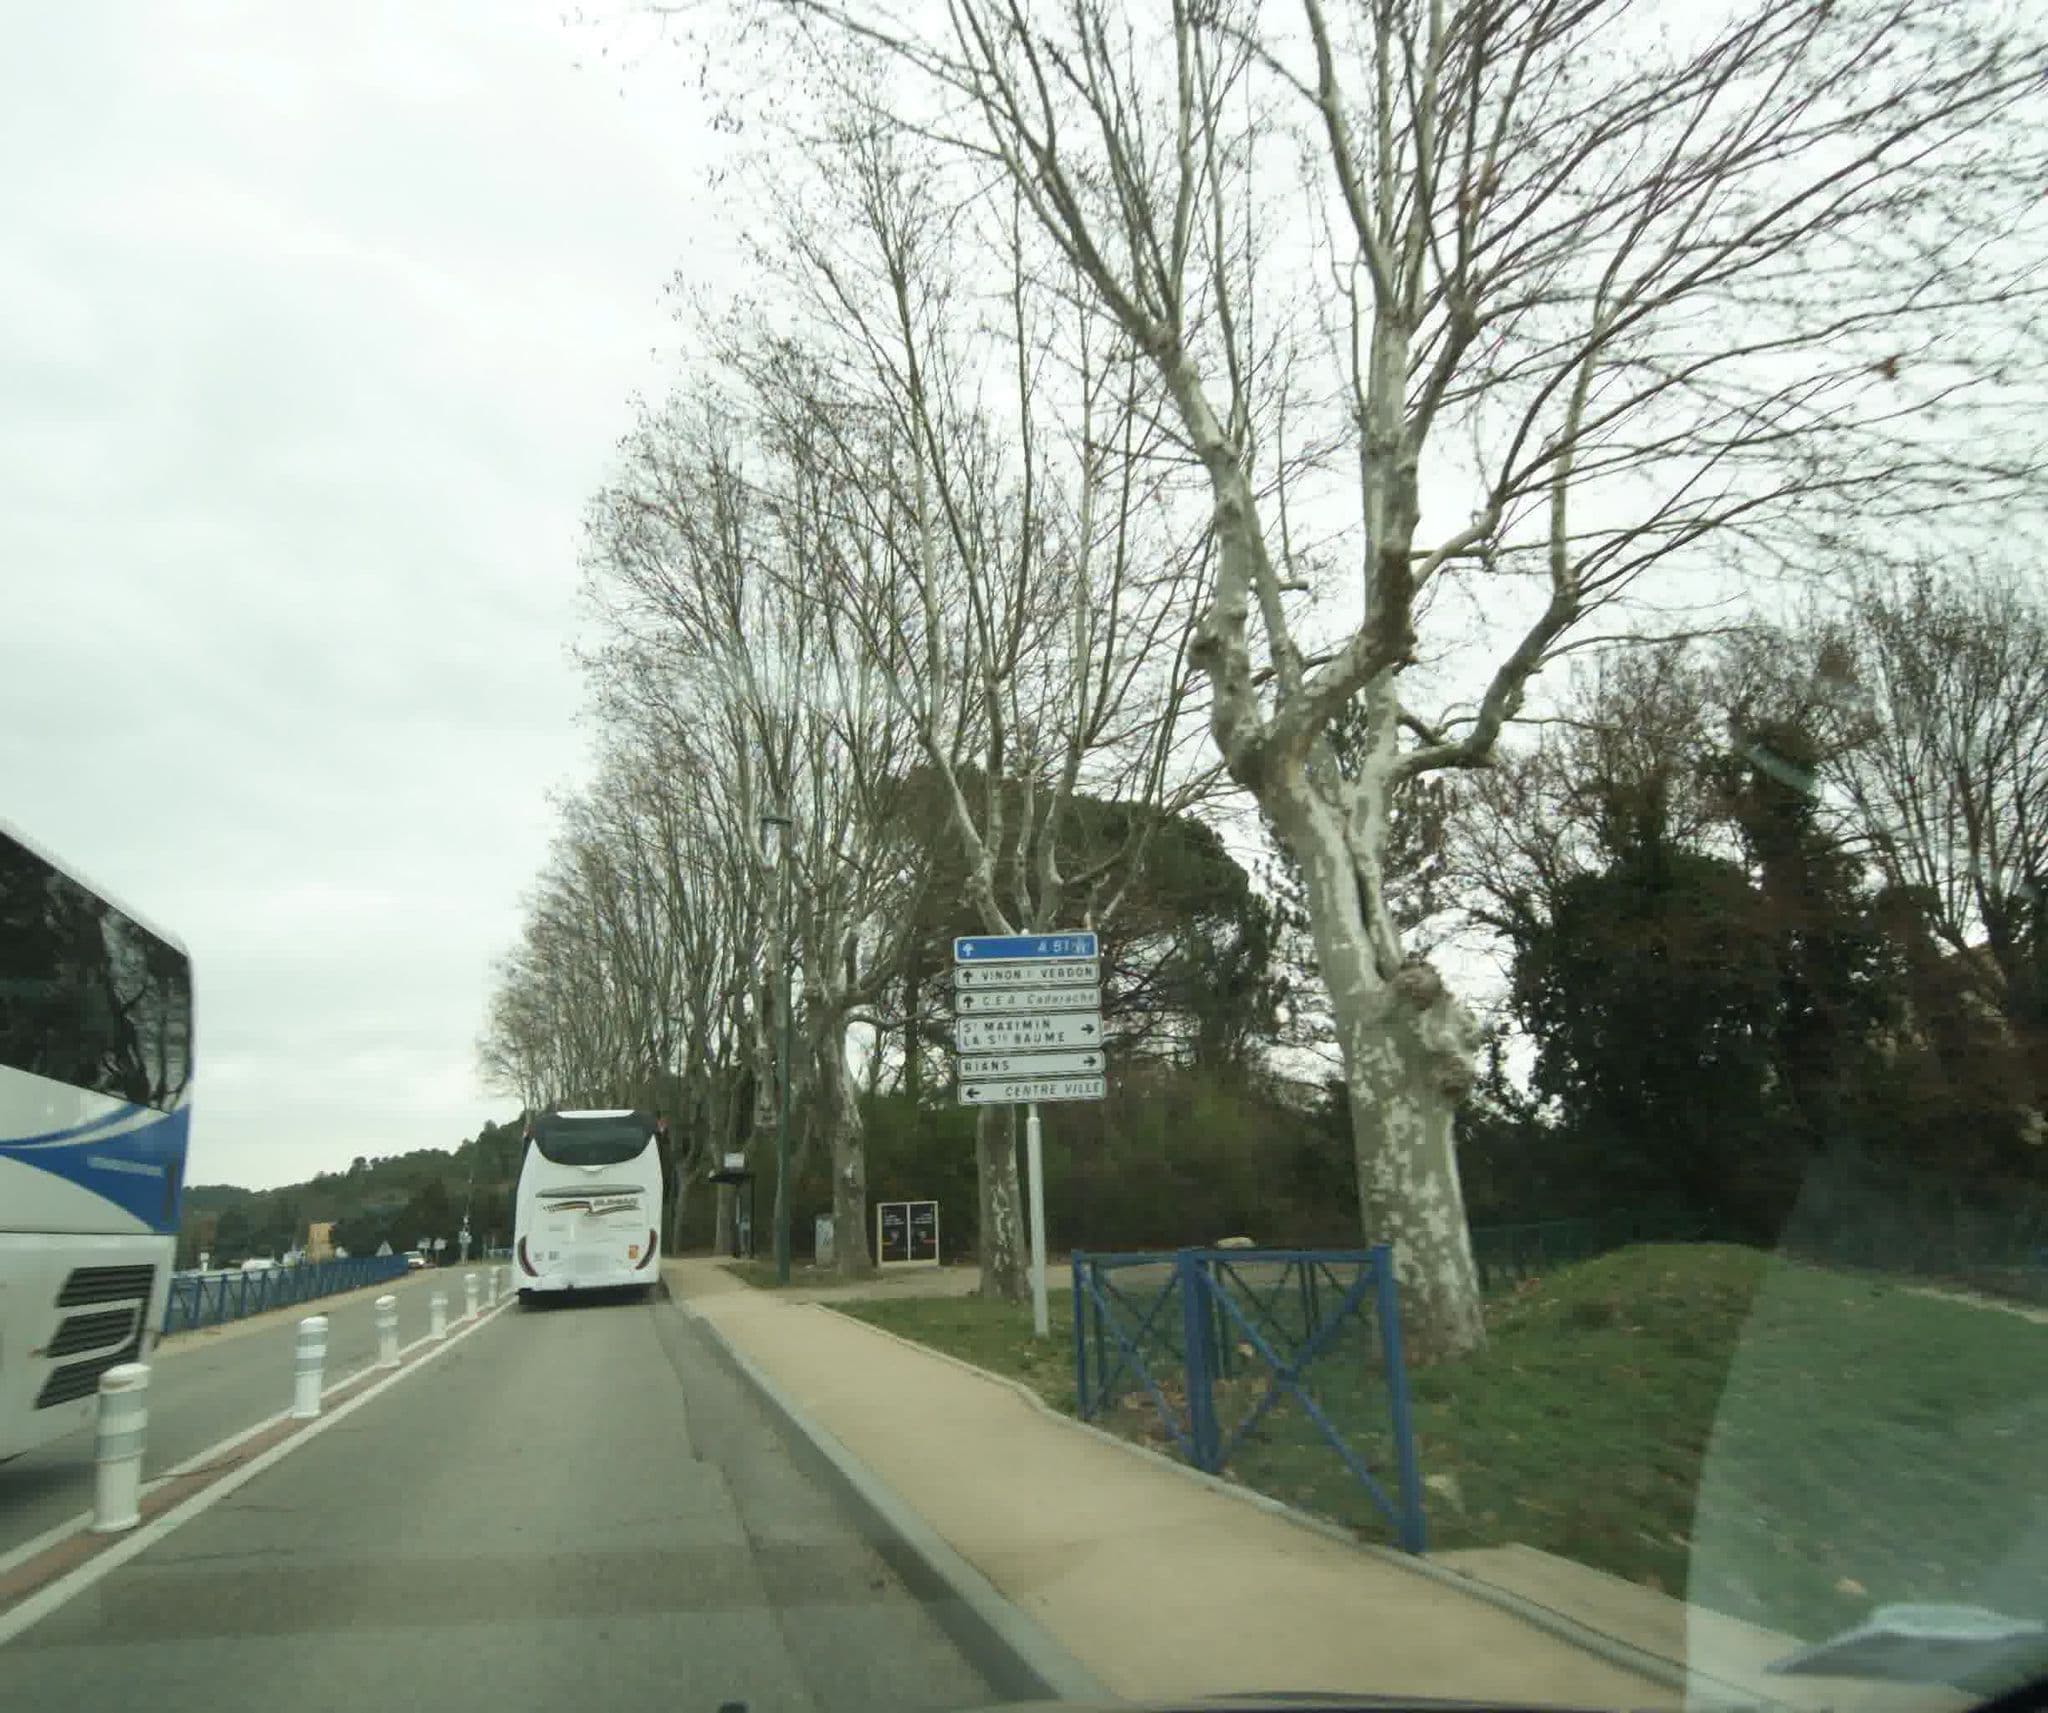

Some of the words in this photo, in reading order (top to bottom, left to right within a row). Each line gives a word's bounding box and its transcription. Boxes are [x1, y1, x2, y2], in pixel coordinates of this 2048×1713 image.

[982, 969, 1021, 982] VINON
[1040, 966, 1092, 978] VERDON
[984, 1018, 1051, 1031] MAXIMIN
[963, 1035, 980, 1047] LA
[1014, 1031, 1065, 1044] BAUME
[964, 1060, 1010, 1071] RIANS
[1005, 1084, 1057, 1097] CENTRE
[1064, 1082, 1100, 1094] VILLE
